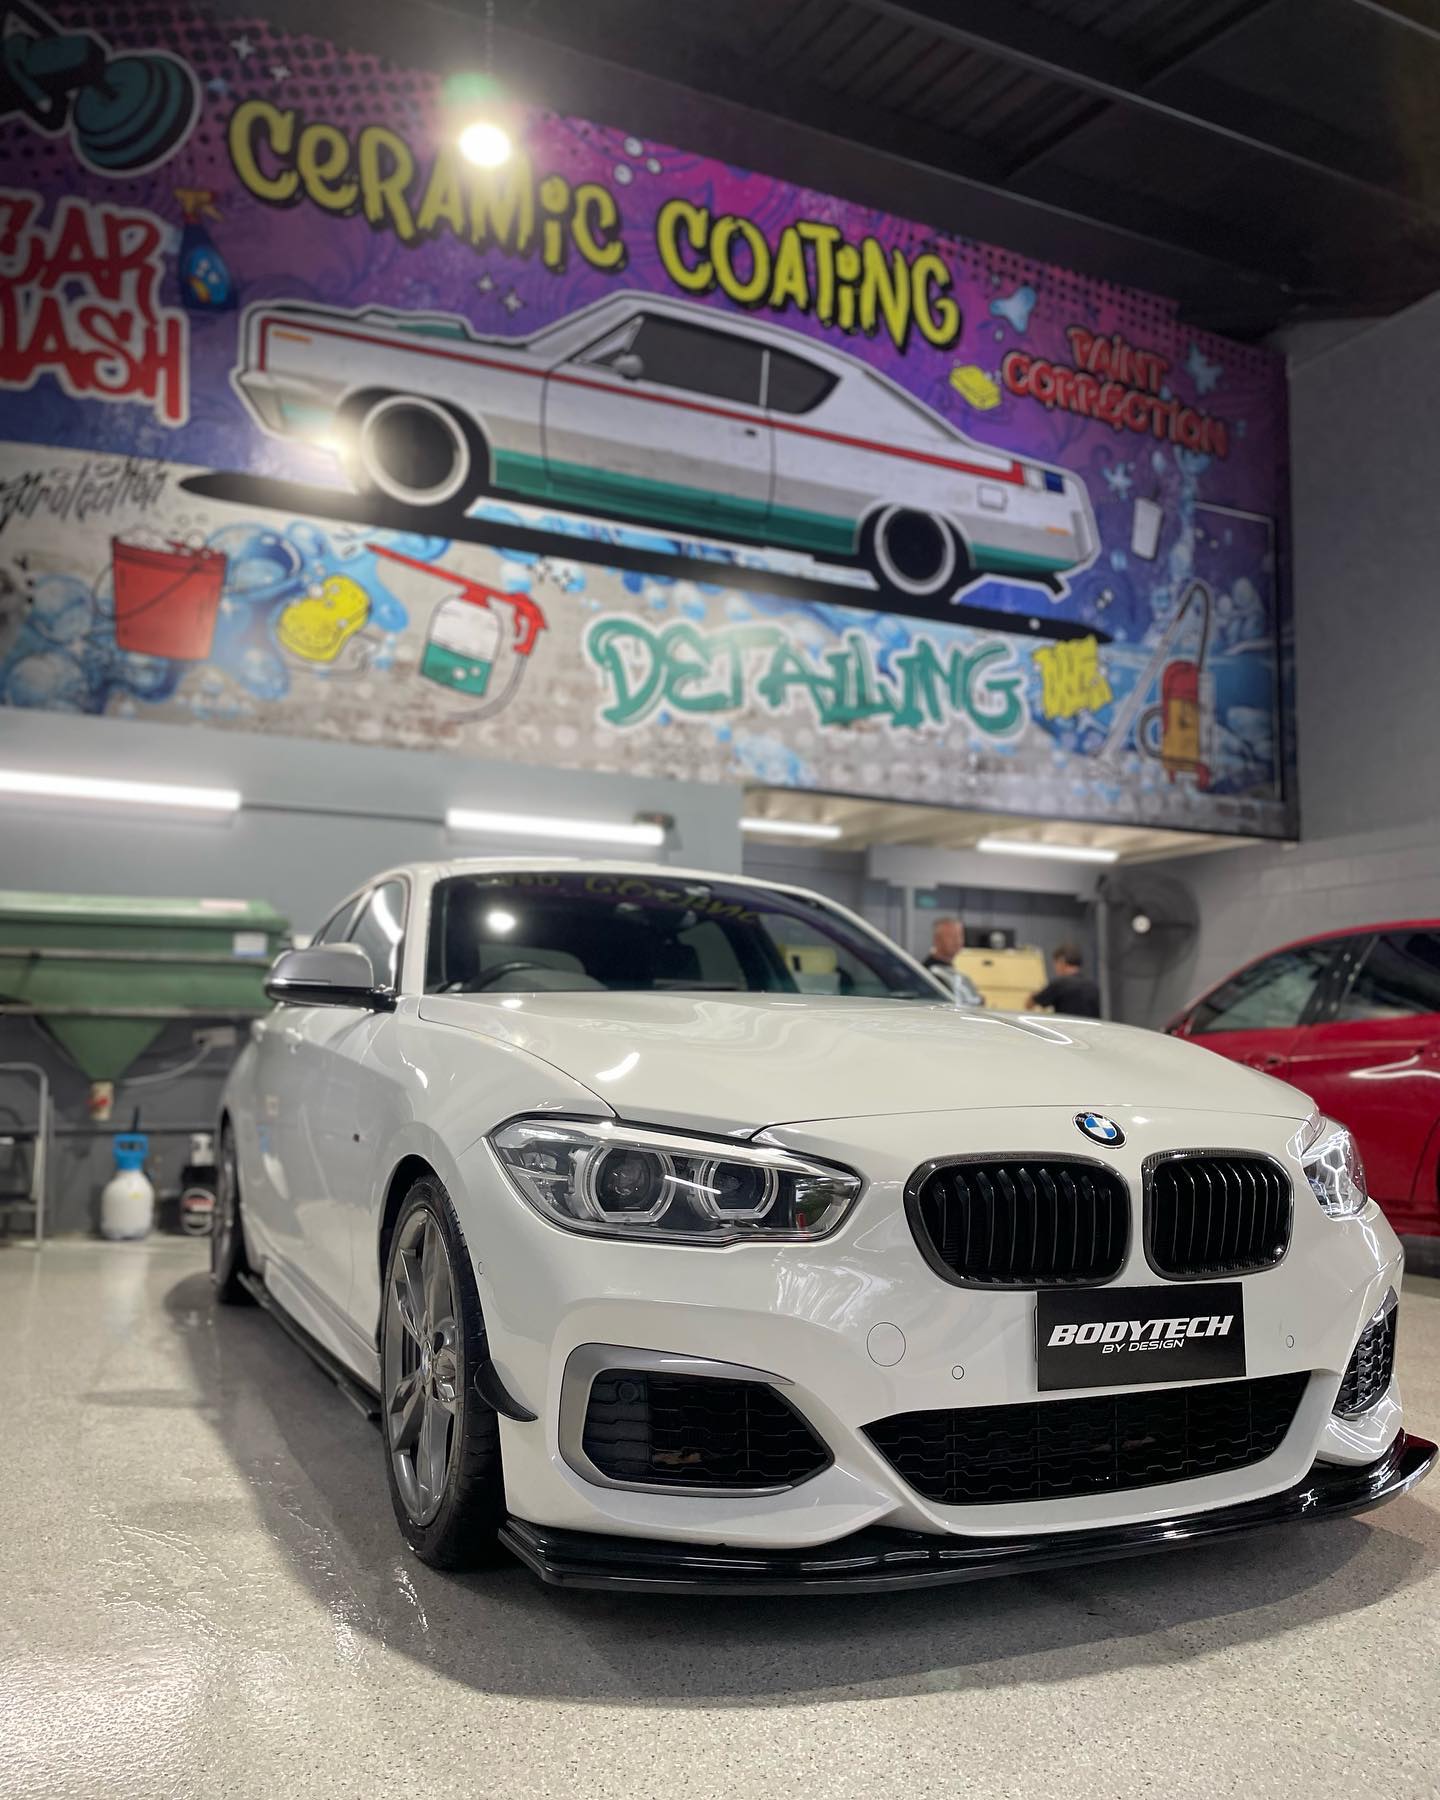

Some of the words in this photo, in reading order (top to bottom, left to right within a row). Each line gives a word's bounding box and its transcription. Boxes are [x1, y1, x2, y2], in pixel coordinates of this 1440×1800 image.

[0, 297, 186, 426] ASH
[1002, 351, 1230, 460] CORRECTION
[584, 616, 1025, 738] DETAILING
[1047, 1315, 1234, 1347] BODYTECH
[1101, 1344, 1125, 1354] BY
[1128, 1338, 1185, 1351] DESIGN
